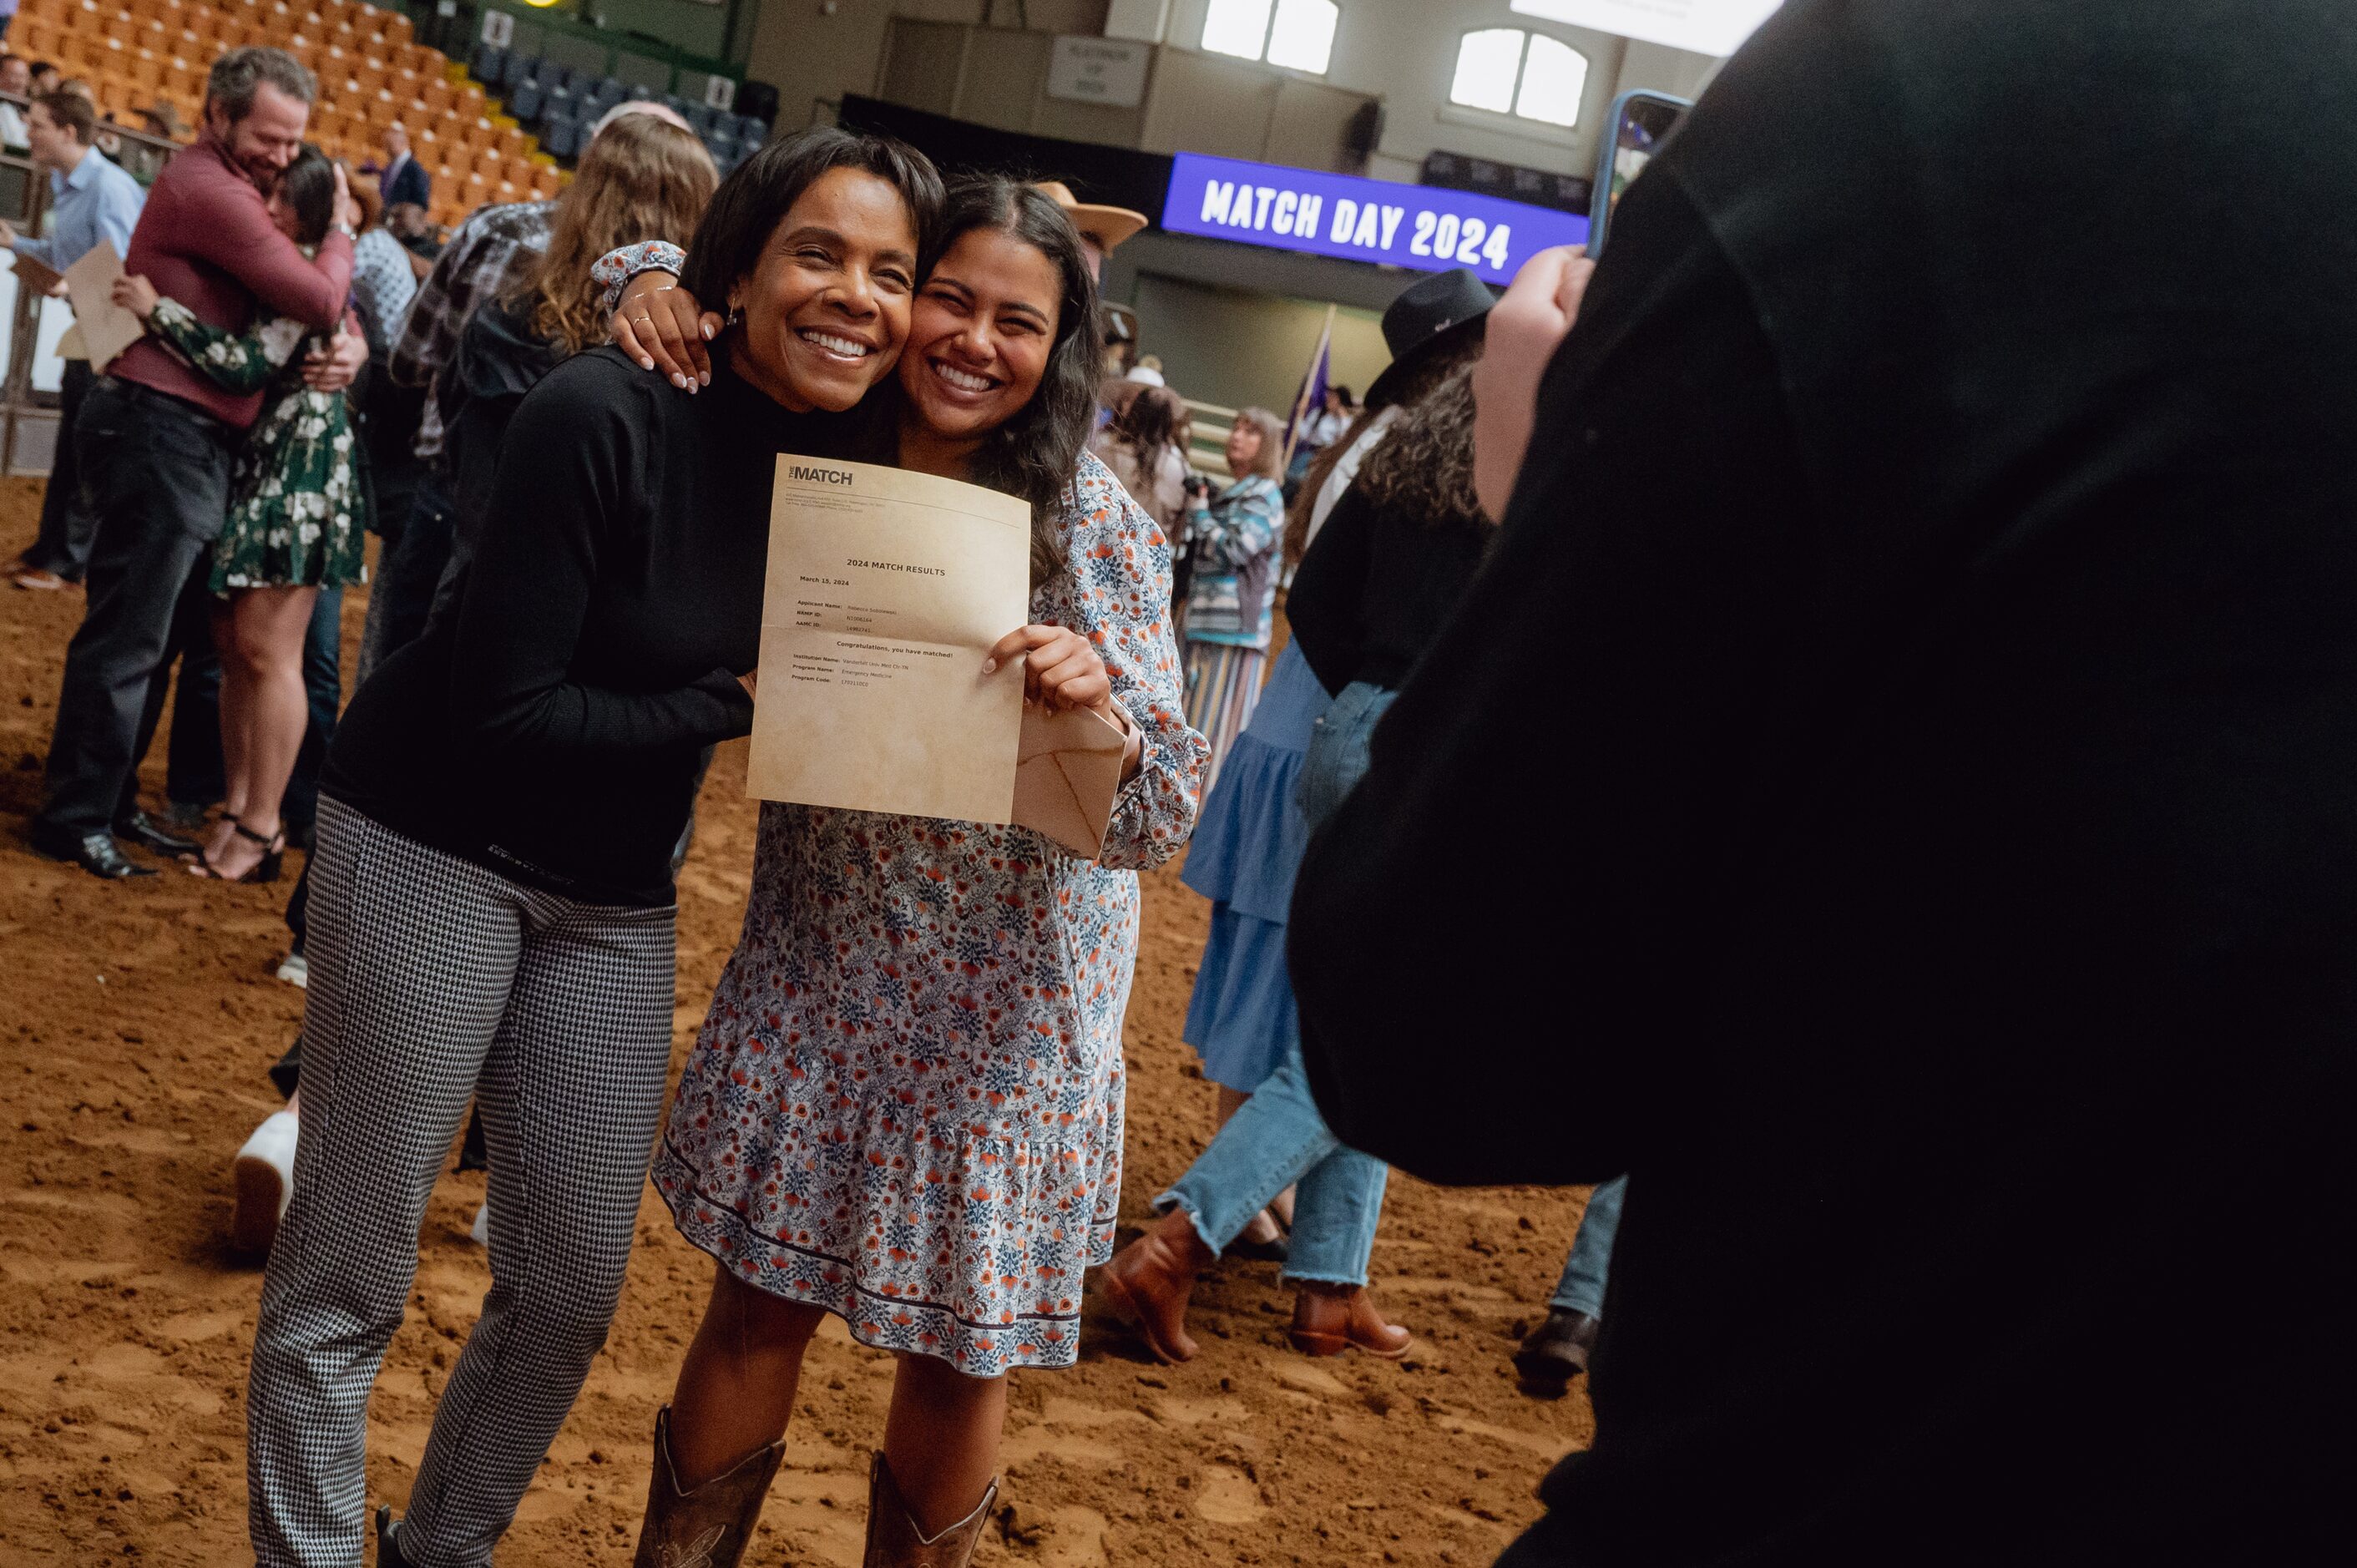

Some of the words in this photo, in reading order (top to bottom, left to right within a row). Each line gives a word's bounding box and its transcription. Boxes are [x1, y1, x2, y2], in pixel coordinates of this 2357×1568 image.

[1200, 178, 1323, 240] MATCH
[1330, 198, 1405, 250] DAY
[1409, 210, 1511, 271] 2024
[794, 466, 852, 486] MATCH
[847, 559, 869, 568] 2024
[871, 561, 903, 572] MATCH
[906, 565, 946, 576] RESULTS
[800, 575, 820, 584] March
[797, 599, 823, 608] Applicant
[837, 640, 890, 653] Congratulations,
[905, 647, 921, 655] have
[923, 650, 953, 659] matched!
[793, 653, 822, 661] Institution
[842, 669, 869, 677] Emergency
